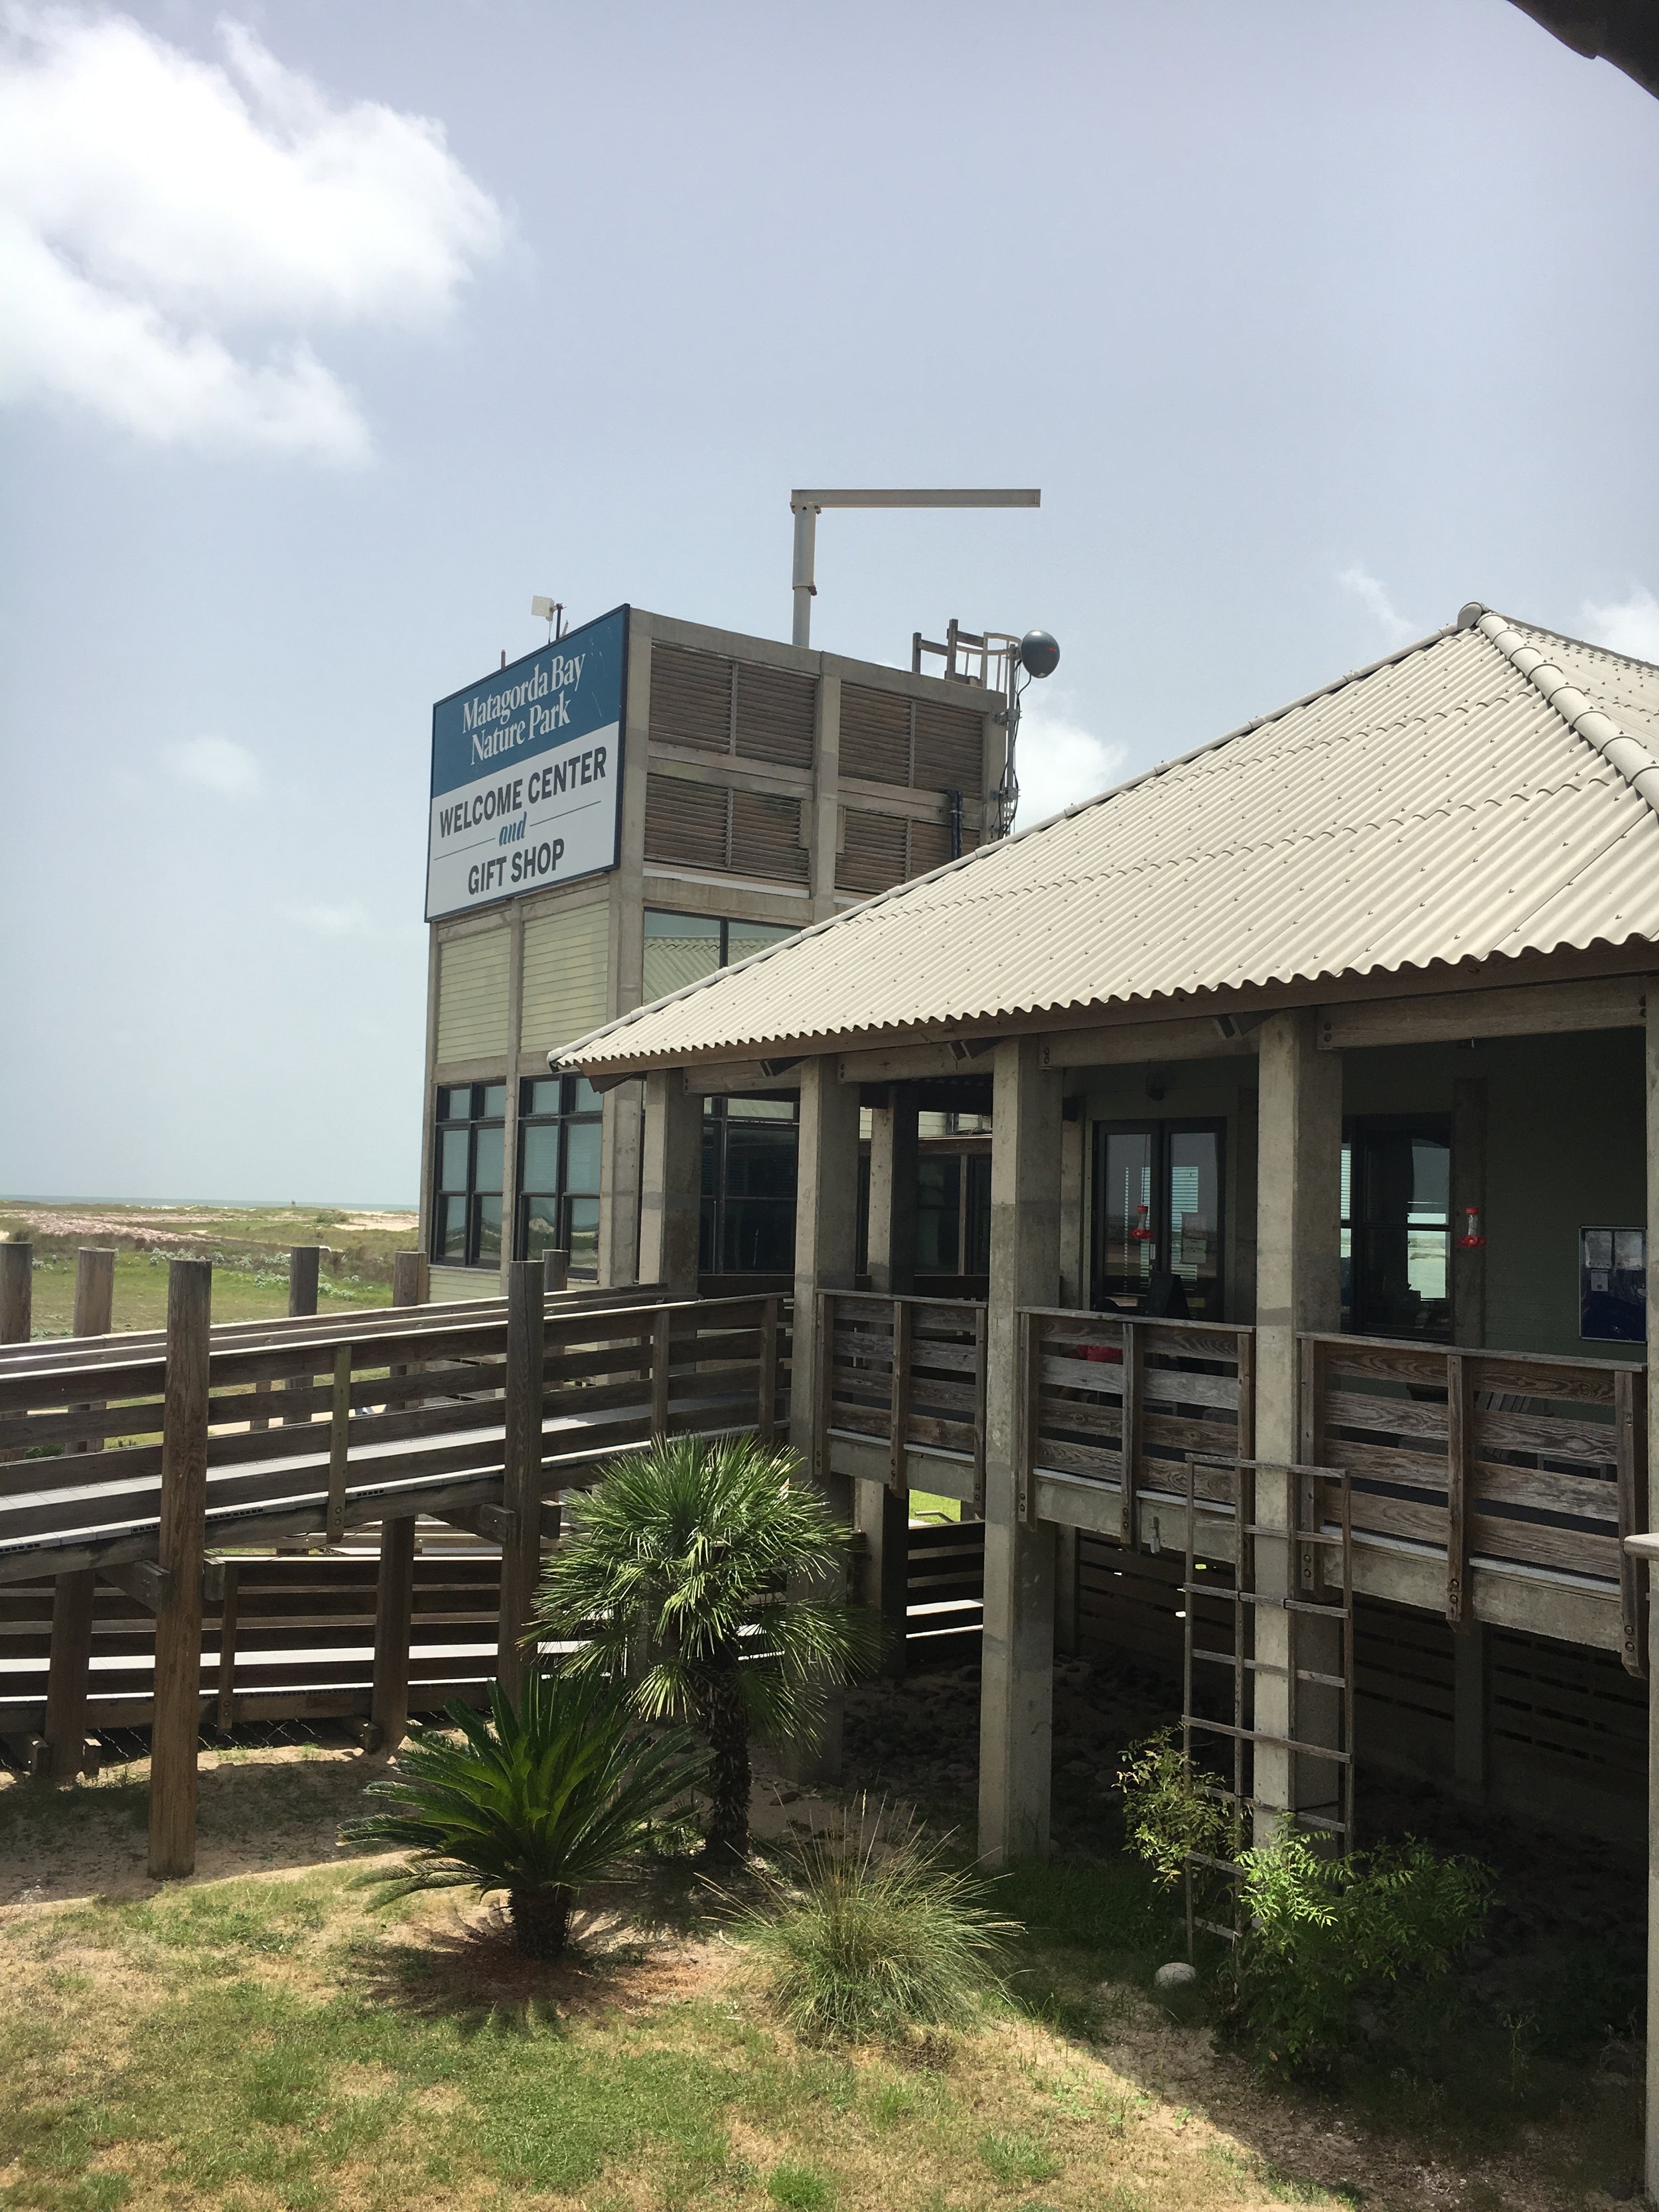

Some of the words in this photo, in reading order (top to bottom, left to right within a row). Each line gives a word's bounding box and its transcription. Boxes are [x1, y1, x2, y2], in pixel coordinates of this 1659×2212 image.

[463, 664, 548, 733] Matagorda
[551, 653, 586, 692] Bay
[471, 721, 526, 765] Nature
[527, 690, 571, 738] Park
[439, 778, 522, 838] WELCOME
[528, 746, 607, 804] CENTER
[498, 811, 528, 846] and
[468, 856, 506, 895] GIFT
[511, 838, 564, 883] SHOP
